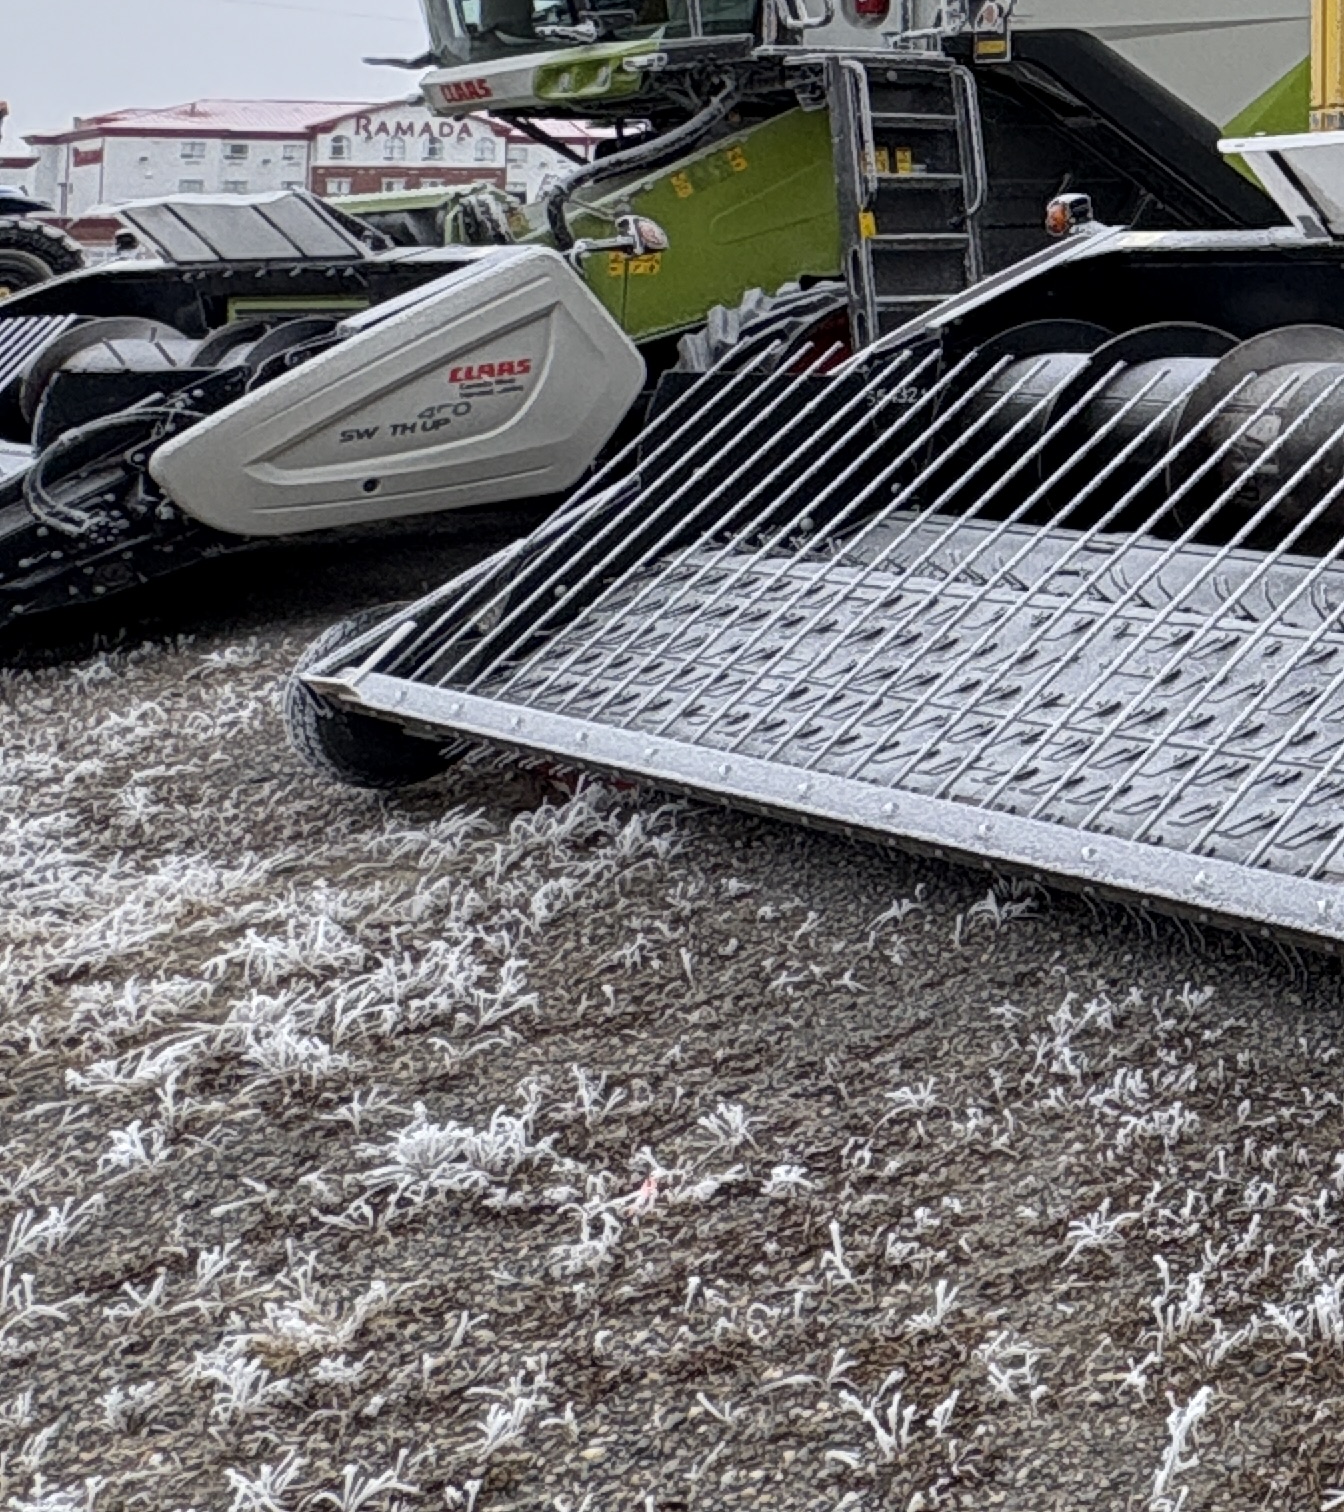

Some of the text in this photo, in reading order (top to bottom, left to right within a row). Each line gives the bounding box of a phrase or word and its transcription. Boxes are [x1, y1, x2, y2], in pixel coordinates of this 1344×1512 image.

[354, 113, 474, 140] RAMADA
[449, 359, 532, 383] CLAAS
[340, 417, 451, 443] SWTH UP
